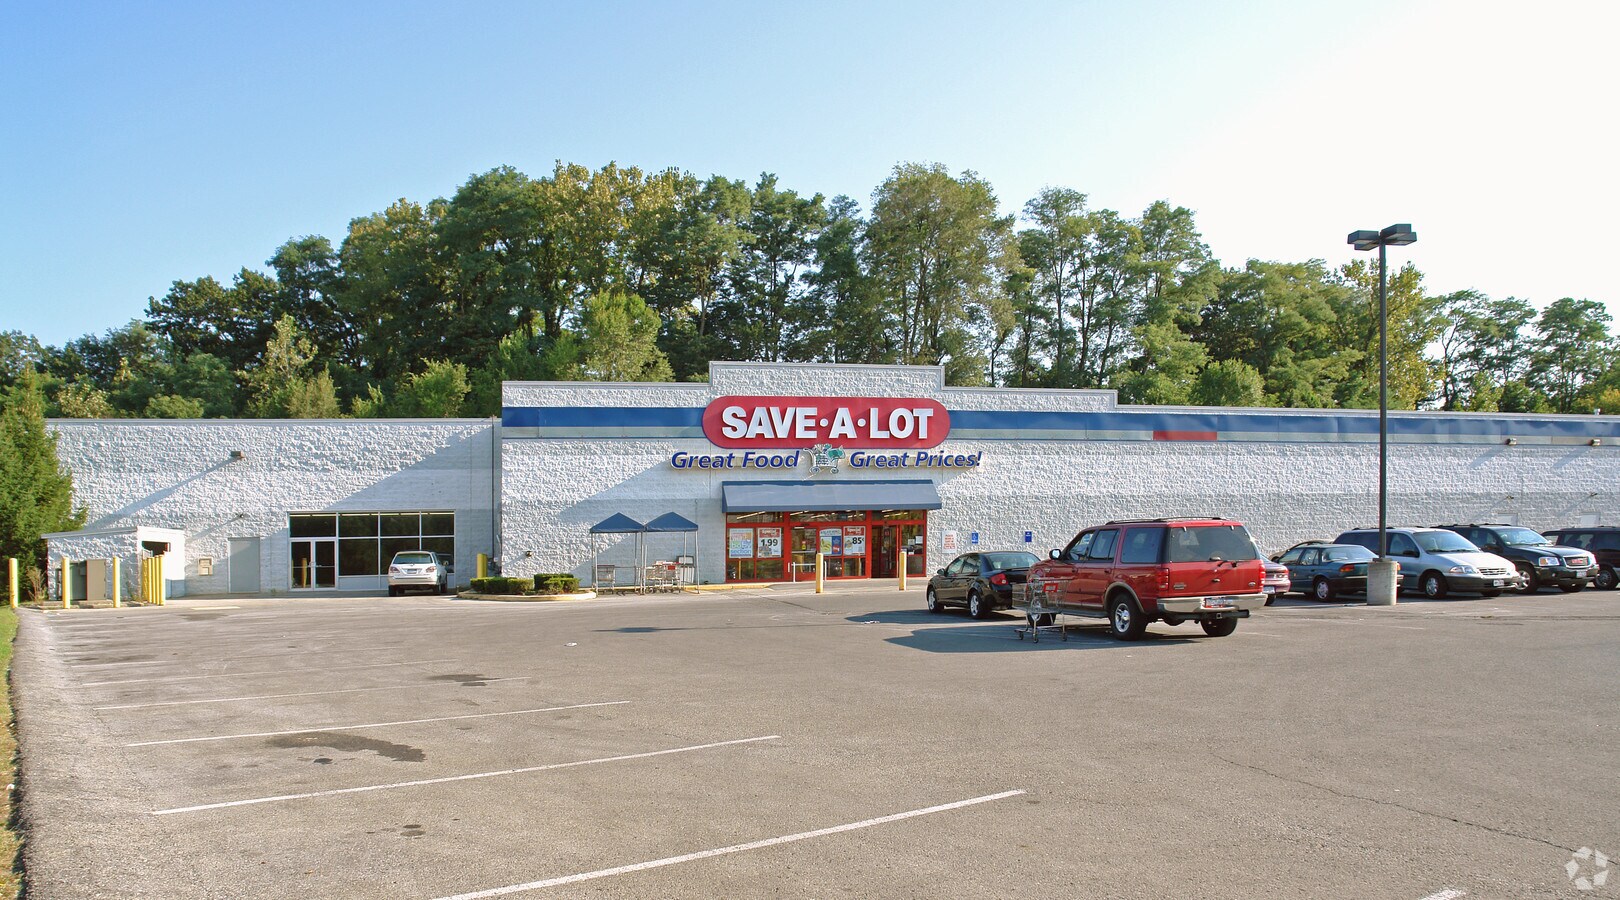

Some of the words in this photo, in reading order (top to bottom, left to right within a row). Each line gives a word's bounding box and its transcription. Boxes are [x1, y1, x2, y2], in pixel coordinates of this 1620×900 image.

[671, 451, 735, 468] Great
[742, 450, 800, 468] Food
[850, 451, 909, 467] Great
[915, 450, 982, 467] Prices!
[760, 538, 778, 547] 1.99
